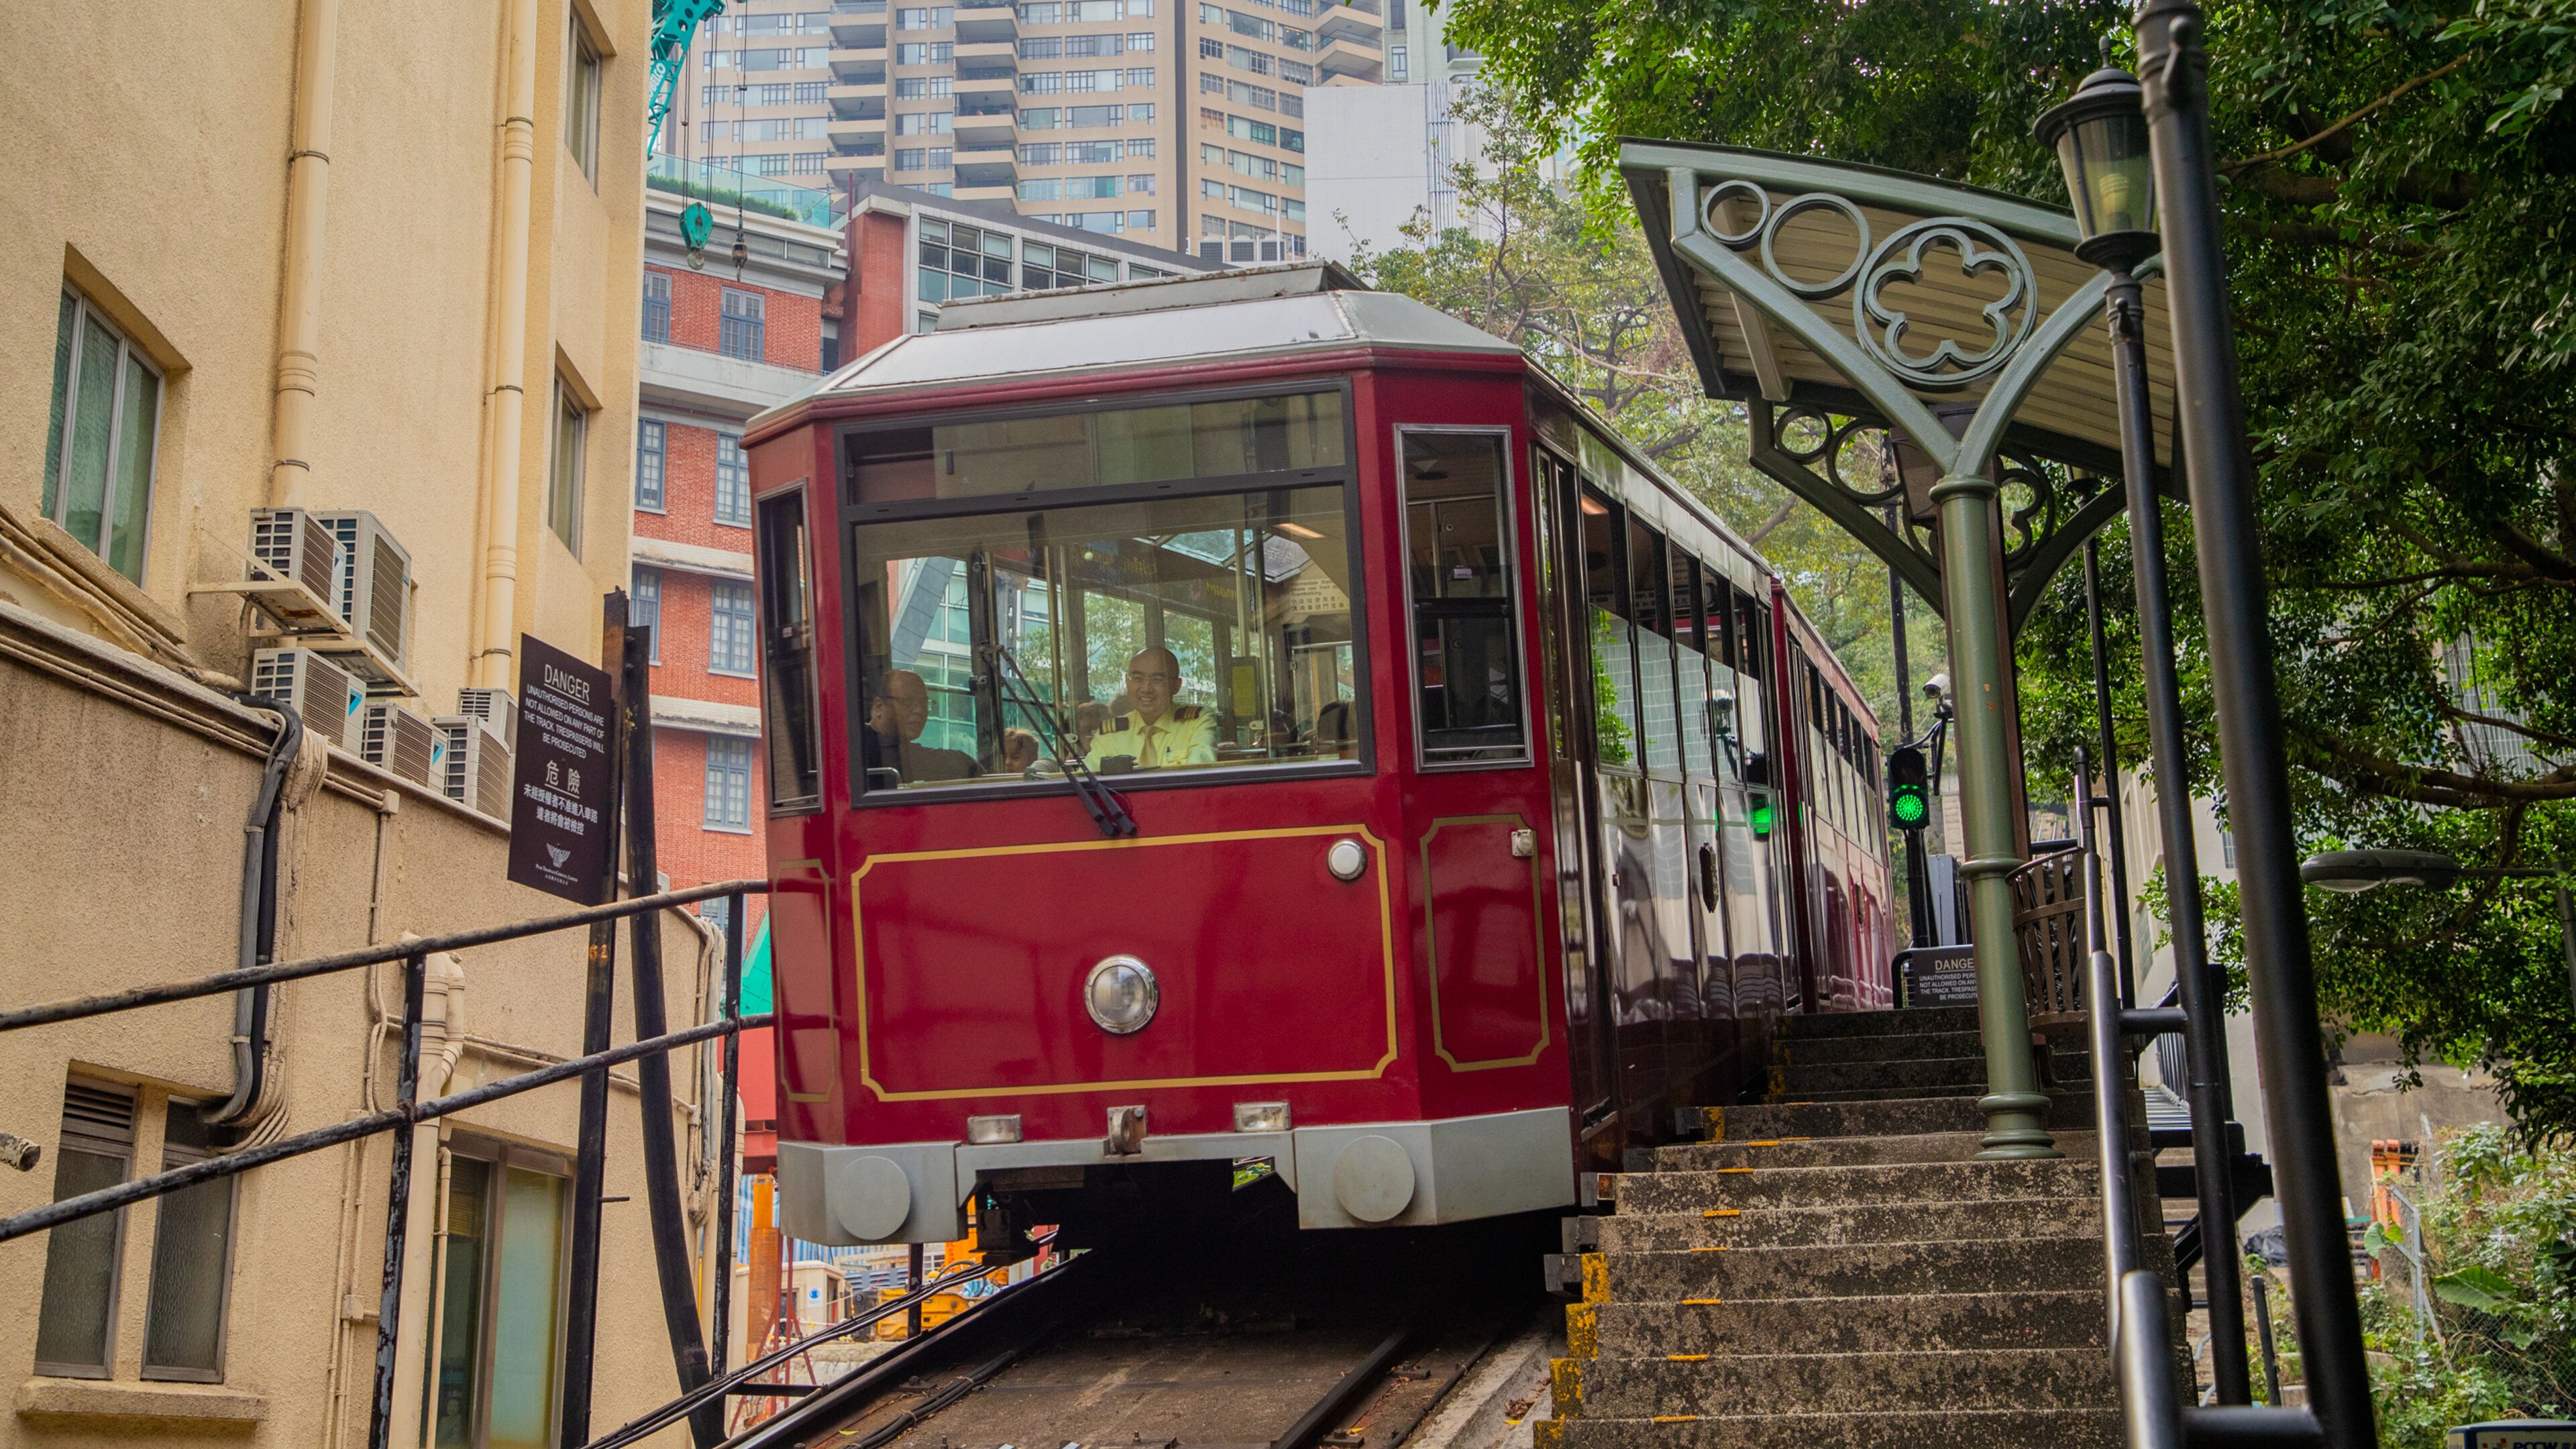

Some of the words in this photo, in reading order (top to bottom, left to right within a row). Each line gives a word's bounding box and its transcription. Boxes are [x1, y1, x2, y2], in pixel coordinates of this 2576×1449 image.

[544, 663, 590, 702] DANGER
[525, 698, 537, 709] NOT
[537, 703, 563, 721] ALLOWED
[564, 714, 572, 725] ON
[572, 718, 584, 729] ANY
[583, 722, 597, 736] PART
[597, 729, 605, 739] OF
[527, 684, 568, 710] UNAUTHORISED
[569, 702, 594, 721] PERSONS
[594, 713, 604, 727] ARE
[524, 710, 535, 723] THE
[555, 724, 593, 747] TRESPASSERS
[592, 741, 605, 753] WILL
[543, 733, 551, 744] BE
[551, 736, 586, 759] PROSECUTED
[545, 759, 581, 796] 危險
[1919, 973, 1962, 981] UNAUTHORISED
[1935, 958, 1974, 970] DANGE
